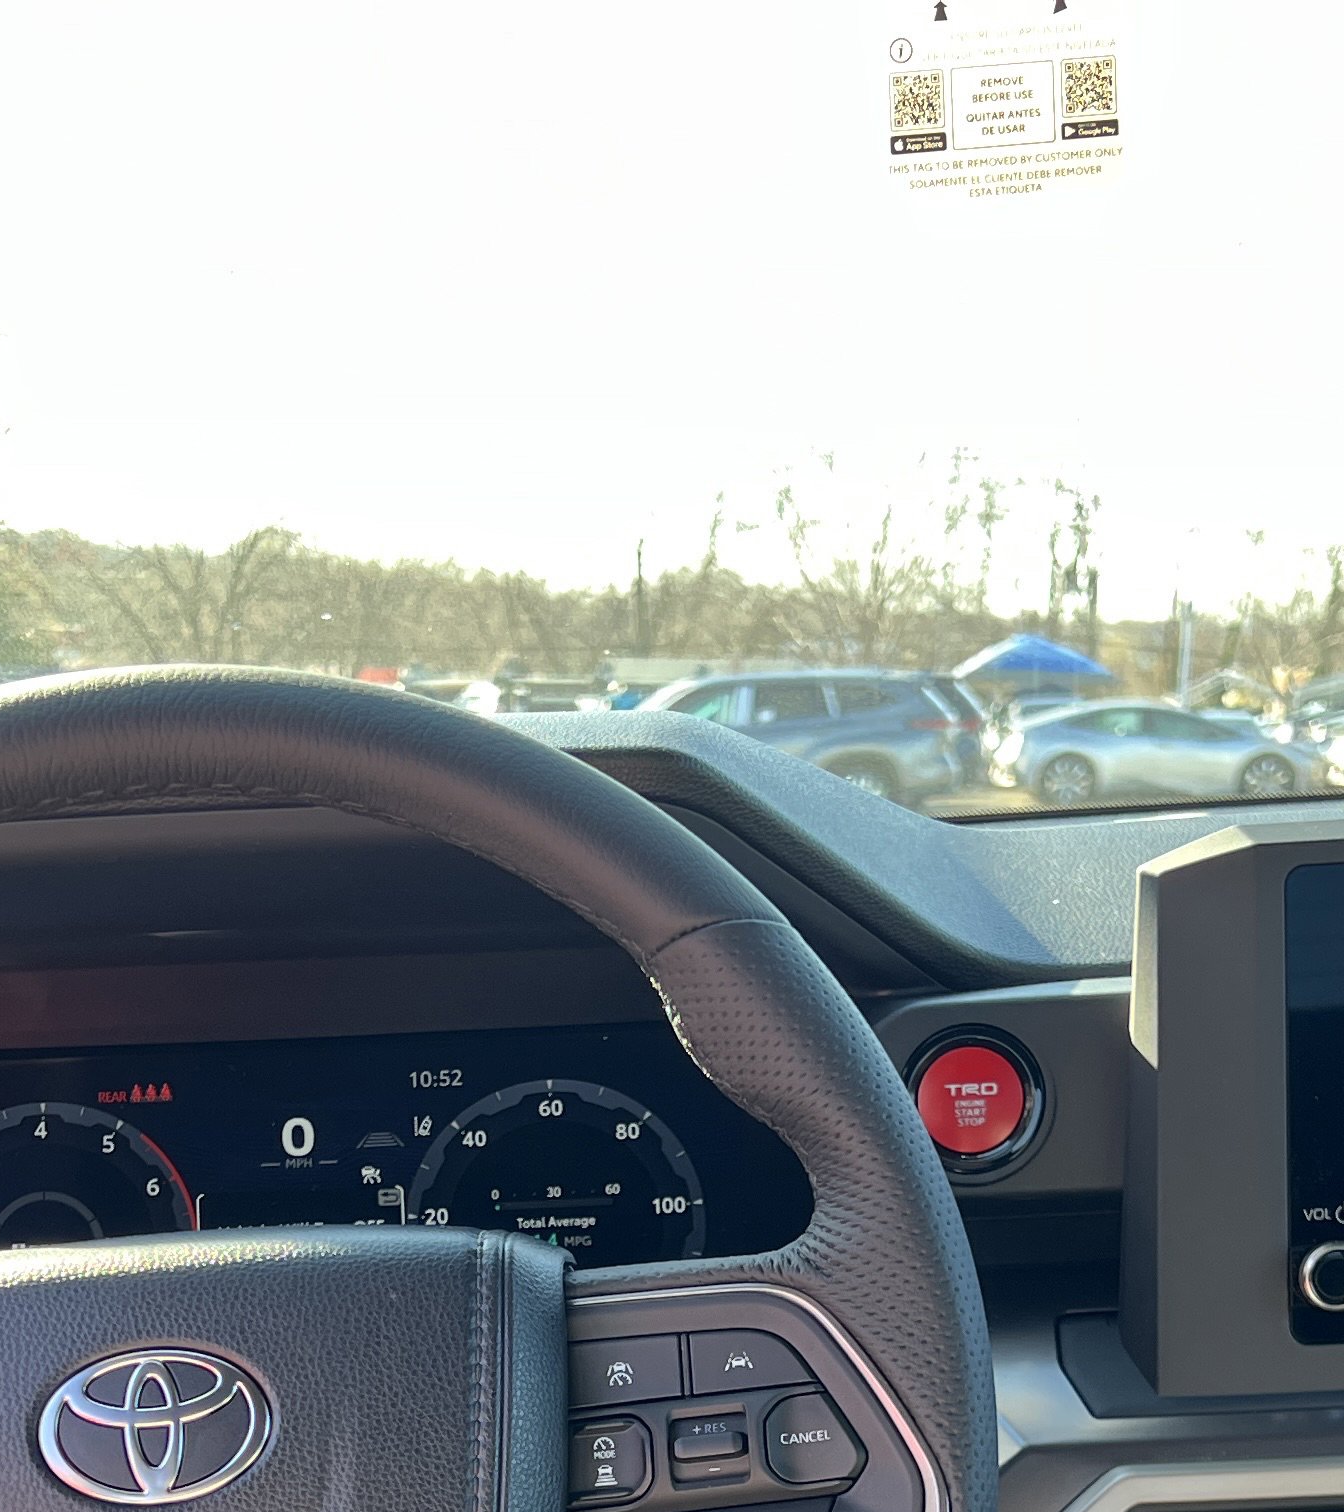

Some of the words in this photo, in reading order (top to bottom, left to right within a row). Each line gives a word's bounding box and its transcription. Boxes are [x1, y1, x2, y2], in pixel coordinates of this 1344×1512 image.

[980, 77, 1024, 88] REMOVE
[972, 91, 1012, 103] BEFORE
[1015, 90, 1034, 100] USE
[965, 111, 1005, 123] QUITAR
[1008, 108, 1041, 119] ANTES
[982, 127, 997, 135] DE
[998, 124, 1025, 134] USAR
[906, 142, 923, 151] App
[924, 140, 943, 149] Store
[889, 165, 909, 174] THIS
[914, 163, 933, 172] TAG
[953, 161, 964, 169] BE
[968, 156, 1017, 167] REMOVED
[1020, 155, 1032, 164] BY
[1036, 149, 1092, 162] CUSTOMER
[1095, 147, 1122, 157] ONLY
[909, 176, 968, 189] SOLAMENTE
[985, 172, 1022, 183] CLIENTE
[1027, 170, 1051, 179] DEBE
[1055, 165, 1102, 177] REMOVER
[969, 188, 992, 197] ESTA
[996, 184, 1042, 195] ETIQUETA
[409, 1069, 463, 1088] 10:52
[98, 1091, 127, 1103] REAR
[944, 1082, 999, 1097] TRD
[538, 1100, 563, 1117] 60
[955, 1100, 986, 1108] ENGINE
[955, 1108, 987, 1117] START
[957, 1117, 986, 1127] STOP
[34, 1121, 48, 1139] 4
[282, 1117, 315, 1157] 0
[615, 1122, 640, 1140] 80
[102, 1135, 114, 1153] 5
[462, 1130, 487, 1148] 40
[285, 1158, 313, 1169] MPH
[146, 1178, 160, 1196] 6
[491, 1189, 499, 1200] 0
[547, 1186, 562, 1198] 30
[605, 1183, 621, 1195] 60
[653, 1196, 687, 1214] 100
[425, 1208, 449, 1226] 20
[1303, 1208, 1332, 1222] VOL
[517, 1217, 546, 1229] Total
[548, 1216, 596, 1230] Average
[564, 1236, 592, 1248] MPG
[780, 1429, 831, 1445] CANCEL
[593, 1449, 616, 1461] MODE
